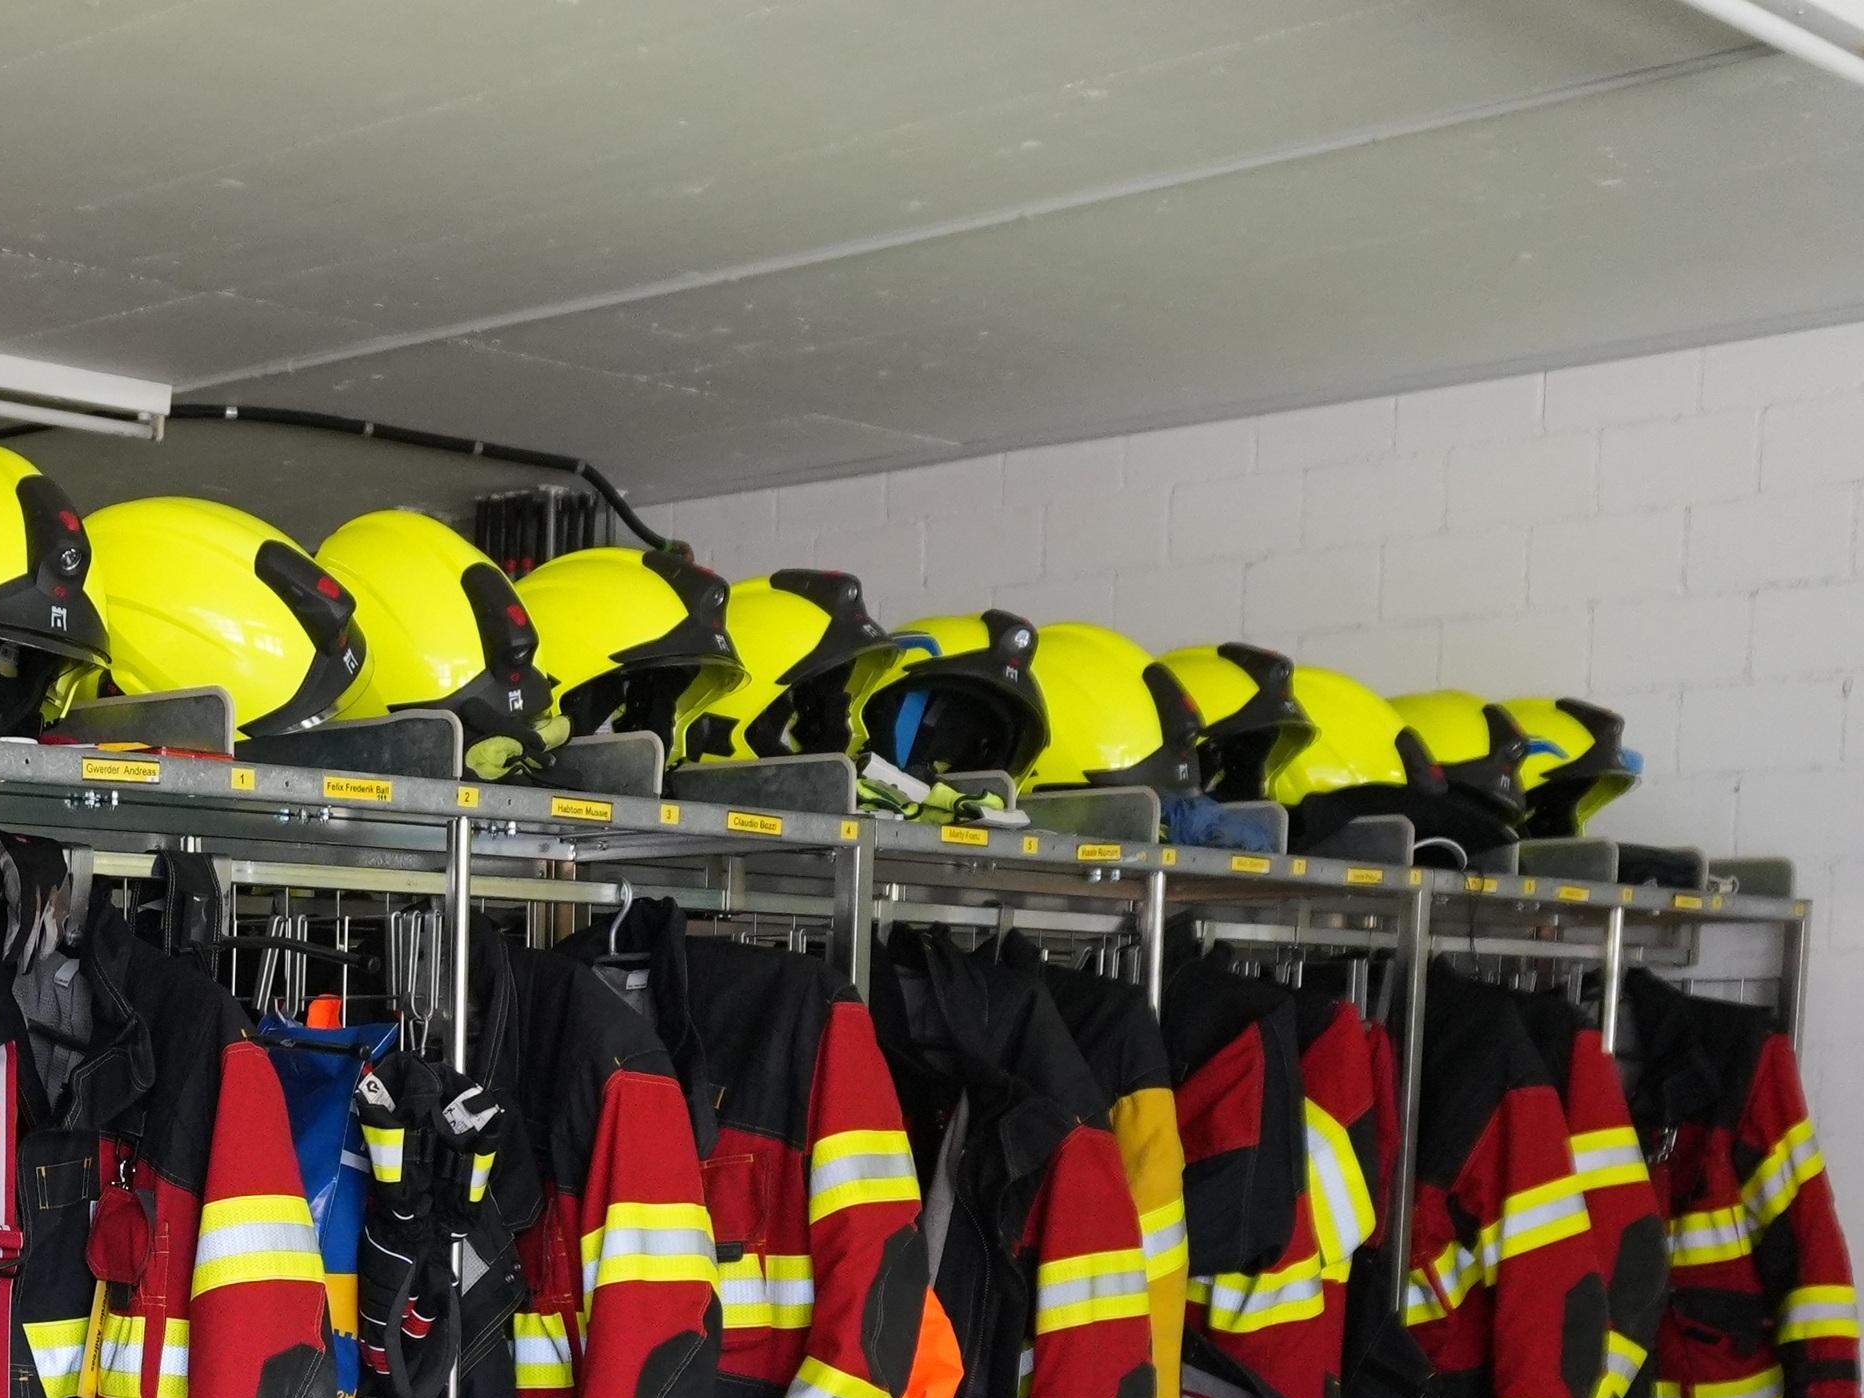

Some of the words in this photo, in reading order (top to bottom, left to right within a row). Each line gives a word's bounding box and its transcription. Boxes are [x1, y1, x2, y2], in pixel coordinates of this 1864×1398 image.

[86, 763, 119, 775] Gwerder
[123, 766, 157, 777] Andreas
[239, 773, 245, 784] 1
[326, 781, 344, 792] Felix
[345, 783, 374, 794] Frederik
[464, 791, 470, 803] 2
[557, 804, 584, 815] Habtom
[666, 809, 672, 820] 3
[846, 826, 852, 835] 4
[1027, 840, 1033, 850] 5
